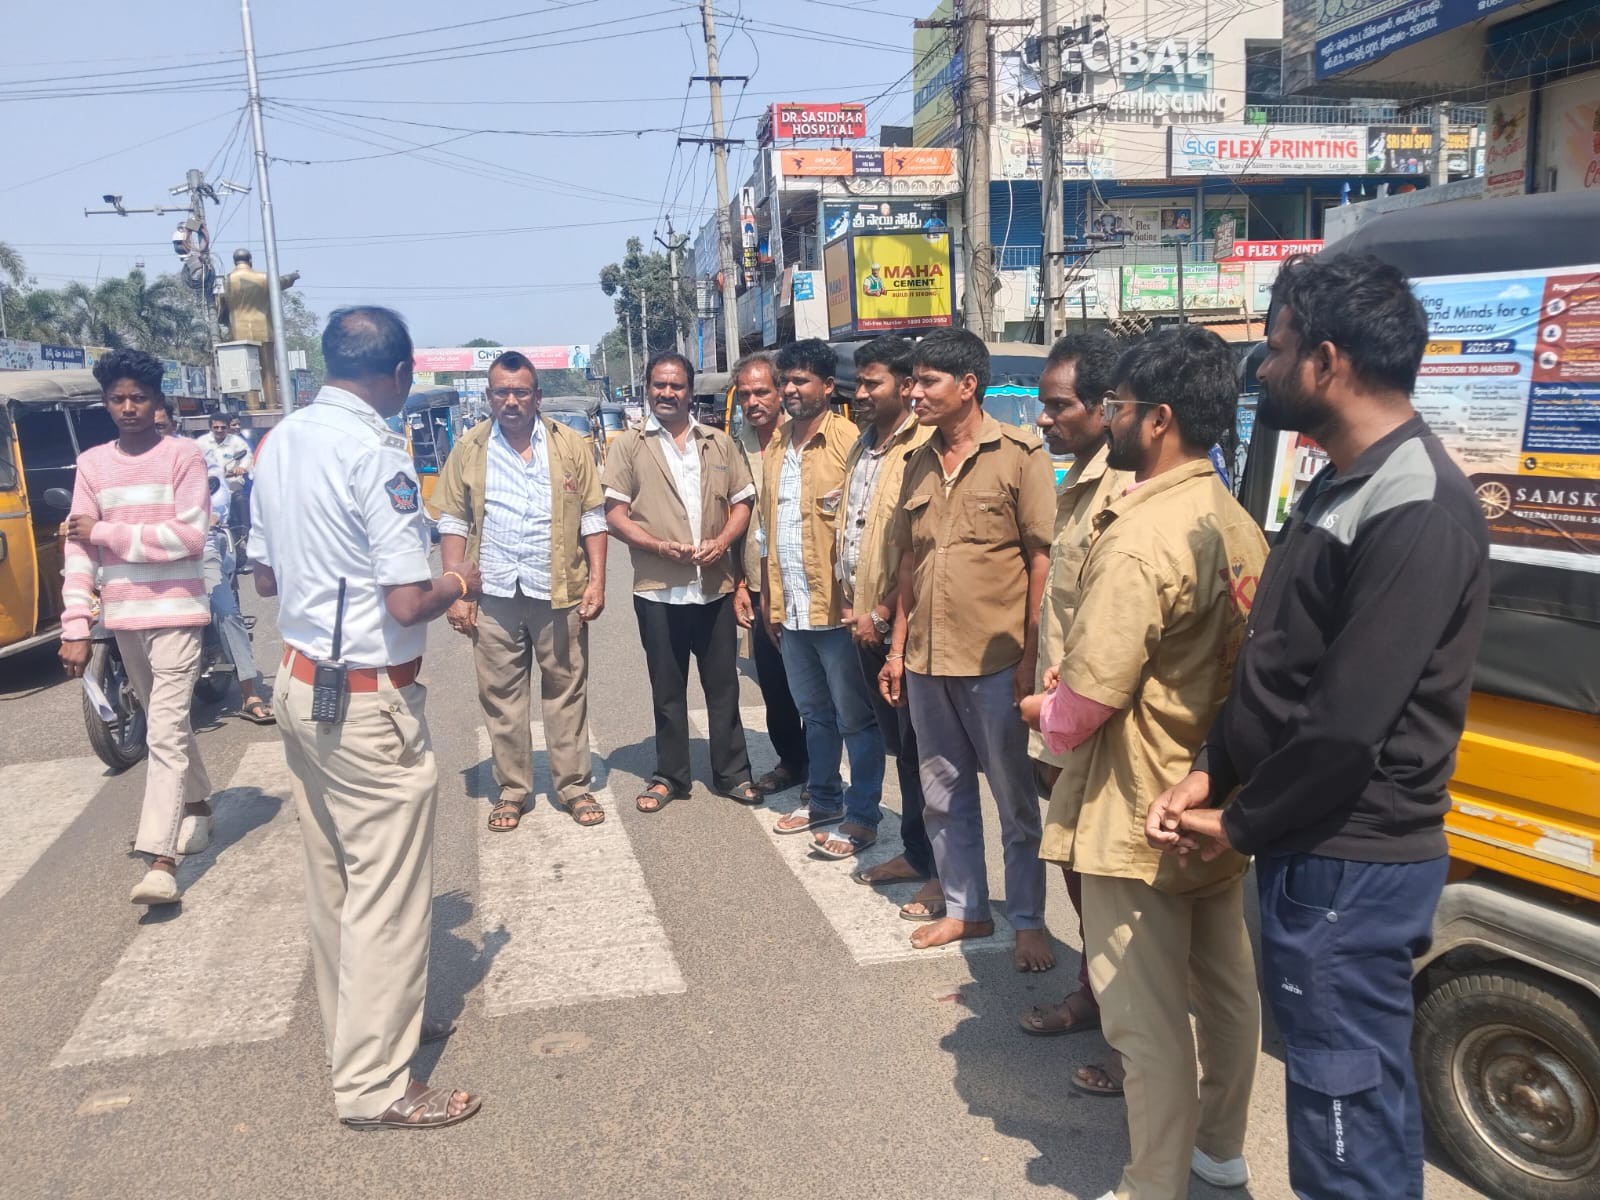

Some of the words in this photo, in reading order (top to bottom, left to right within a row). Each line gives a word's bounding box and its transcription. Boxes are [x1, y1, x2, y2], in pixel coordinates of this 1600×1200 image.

[1409, 17, 1438, 37] 532001
[1171, 93, 1228, 113] CLINIC
[781, 111, 862, 123] DR.SASIDHAR
[792, 124, 854, 135] HOSPITAL
[1186, 140, 1216, 155] SLG
[1218, 140, 1262, 160] FLEX
[1269, 140, 1358, 160] PRINTING
[1249, 245, 1277, 257] FLEX
[884, 263, 943, 279] MAHA
[893, 279, 935, 288] CEMENT
[1454, 305, 1493, 319] Minds
[1497, 303, 1515, 317] for
[1520, 306, 1530, 316] a
[1433, 321, 1496, 334] Tomorrow
[1429, 343, 1455, 354] Open
[1420, 366, 1467, 375] MONTESSORI
[1479, 365, 1515, 374] MASTERY
[1534, 386, 1562, 396] Special
[1515, 487, 1600, 508] SAMSK
